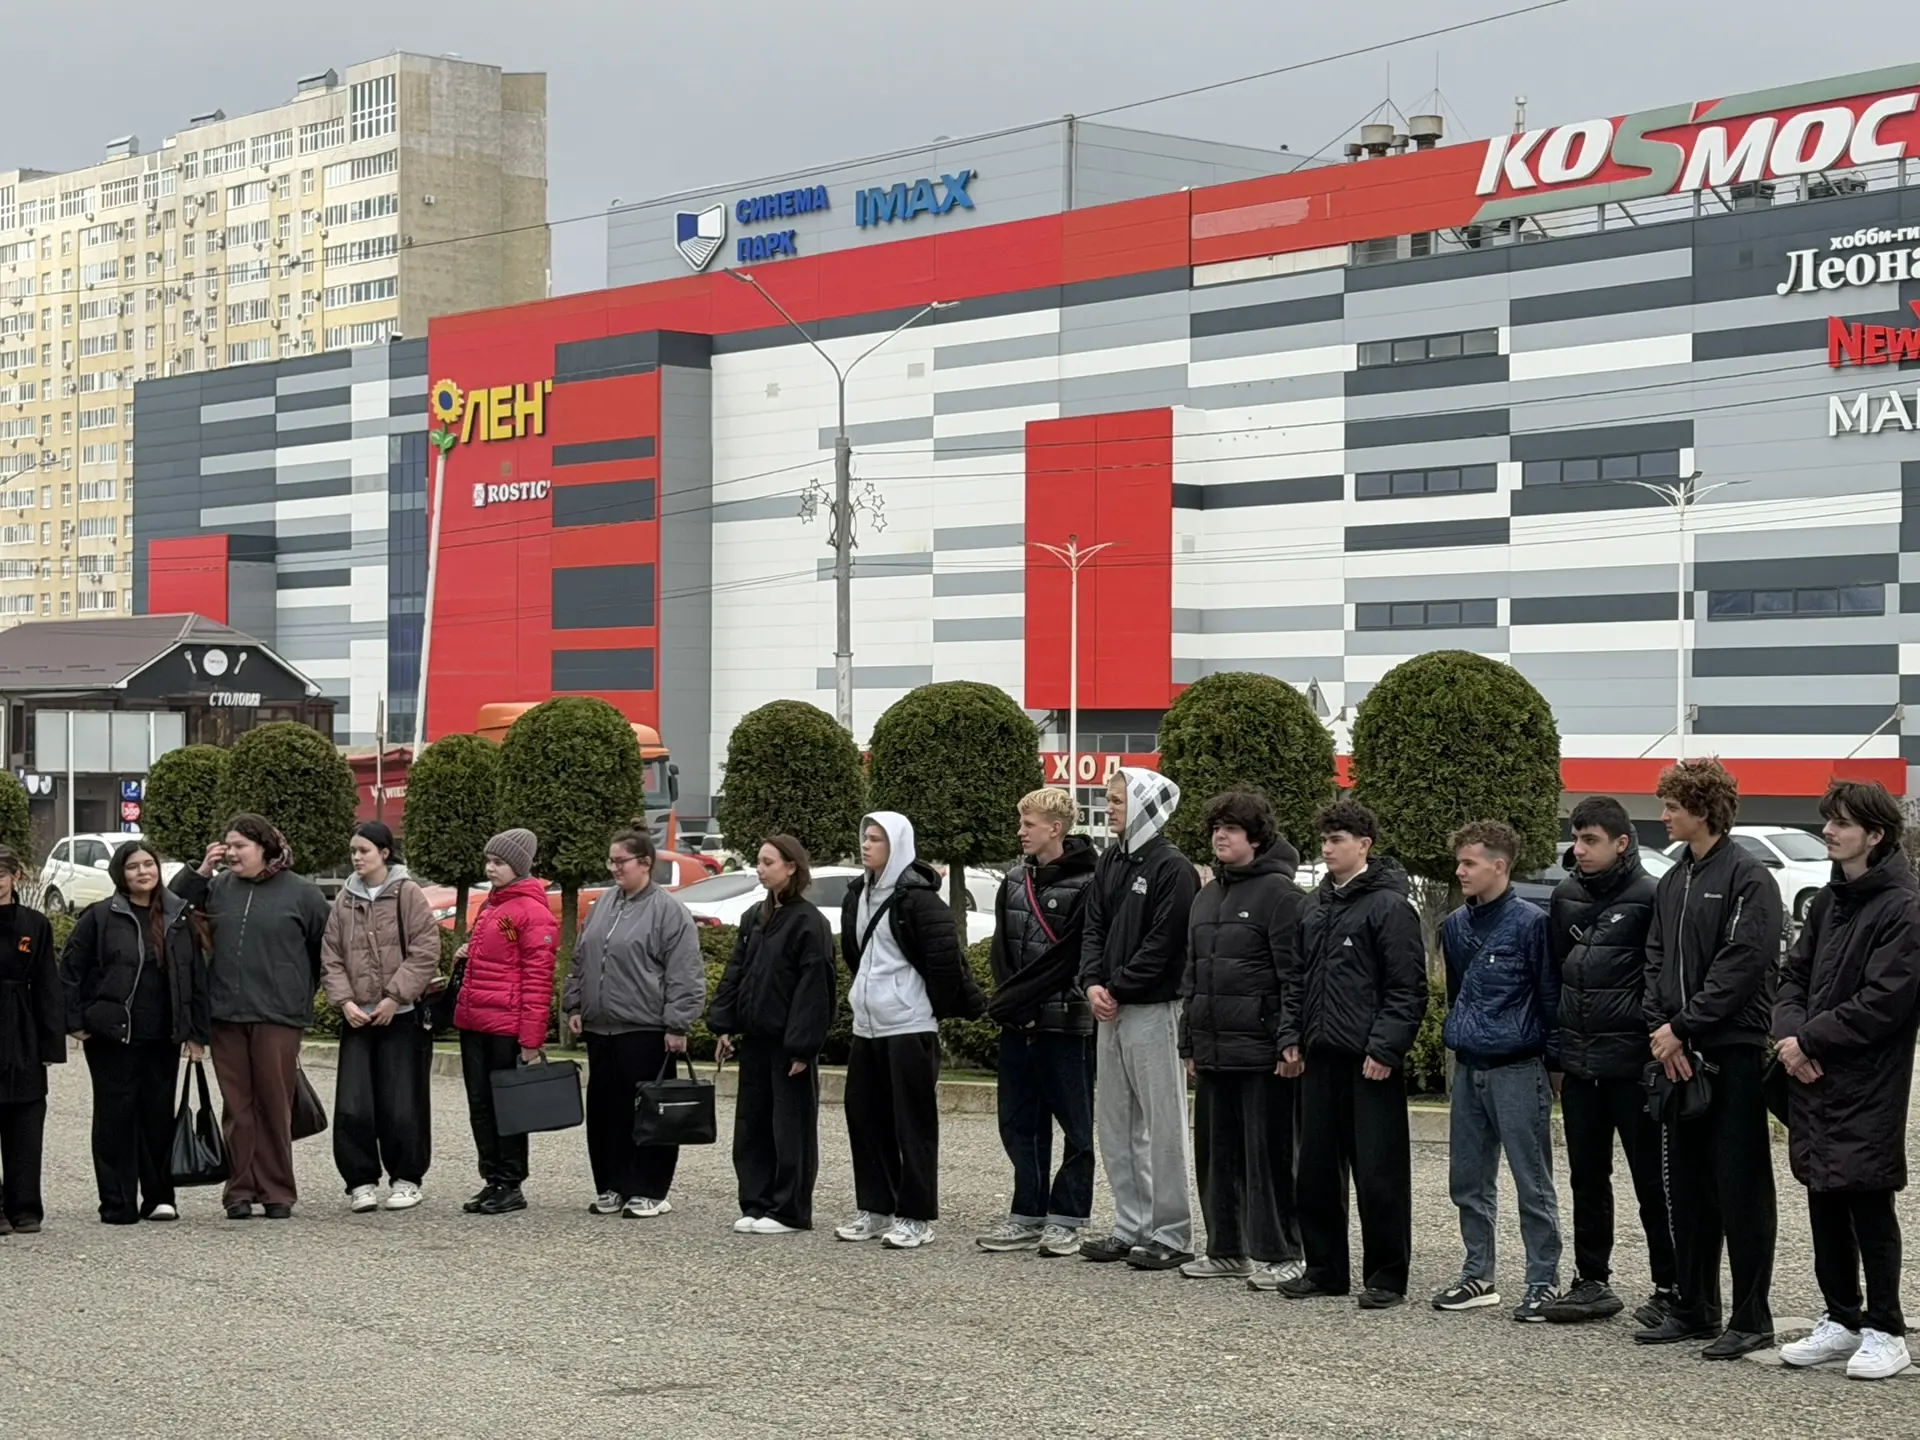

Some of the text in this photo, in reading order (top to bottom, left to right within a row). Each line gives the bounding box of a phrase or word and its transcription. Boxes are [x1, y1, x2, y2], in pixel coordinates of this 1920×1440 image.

[736, 185, 830, 224] СИНЕМА
[855, 169, 976, 227] IMAX
[737, 229, 797, 262] ПАРК
[1828, 388, 1920, 437] MA
[1038, 754, 1121, 786] ХОД
